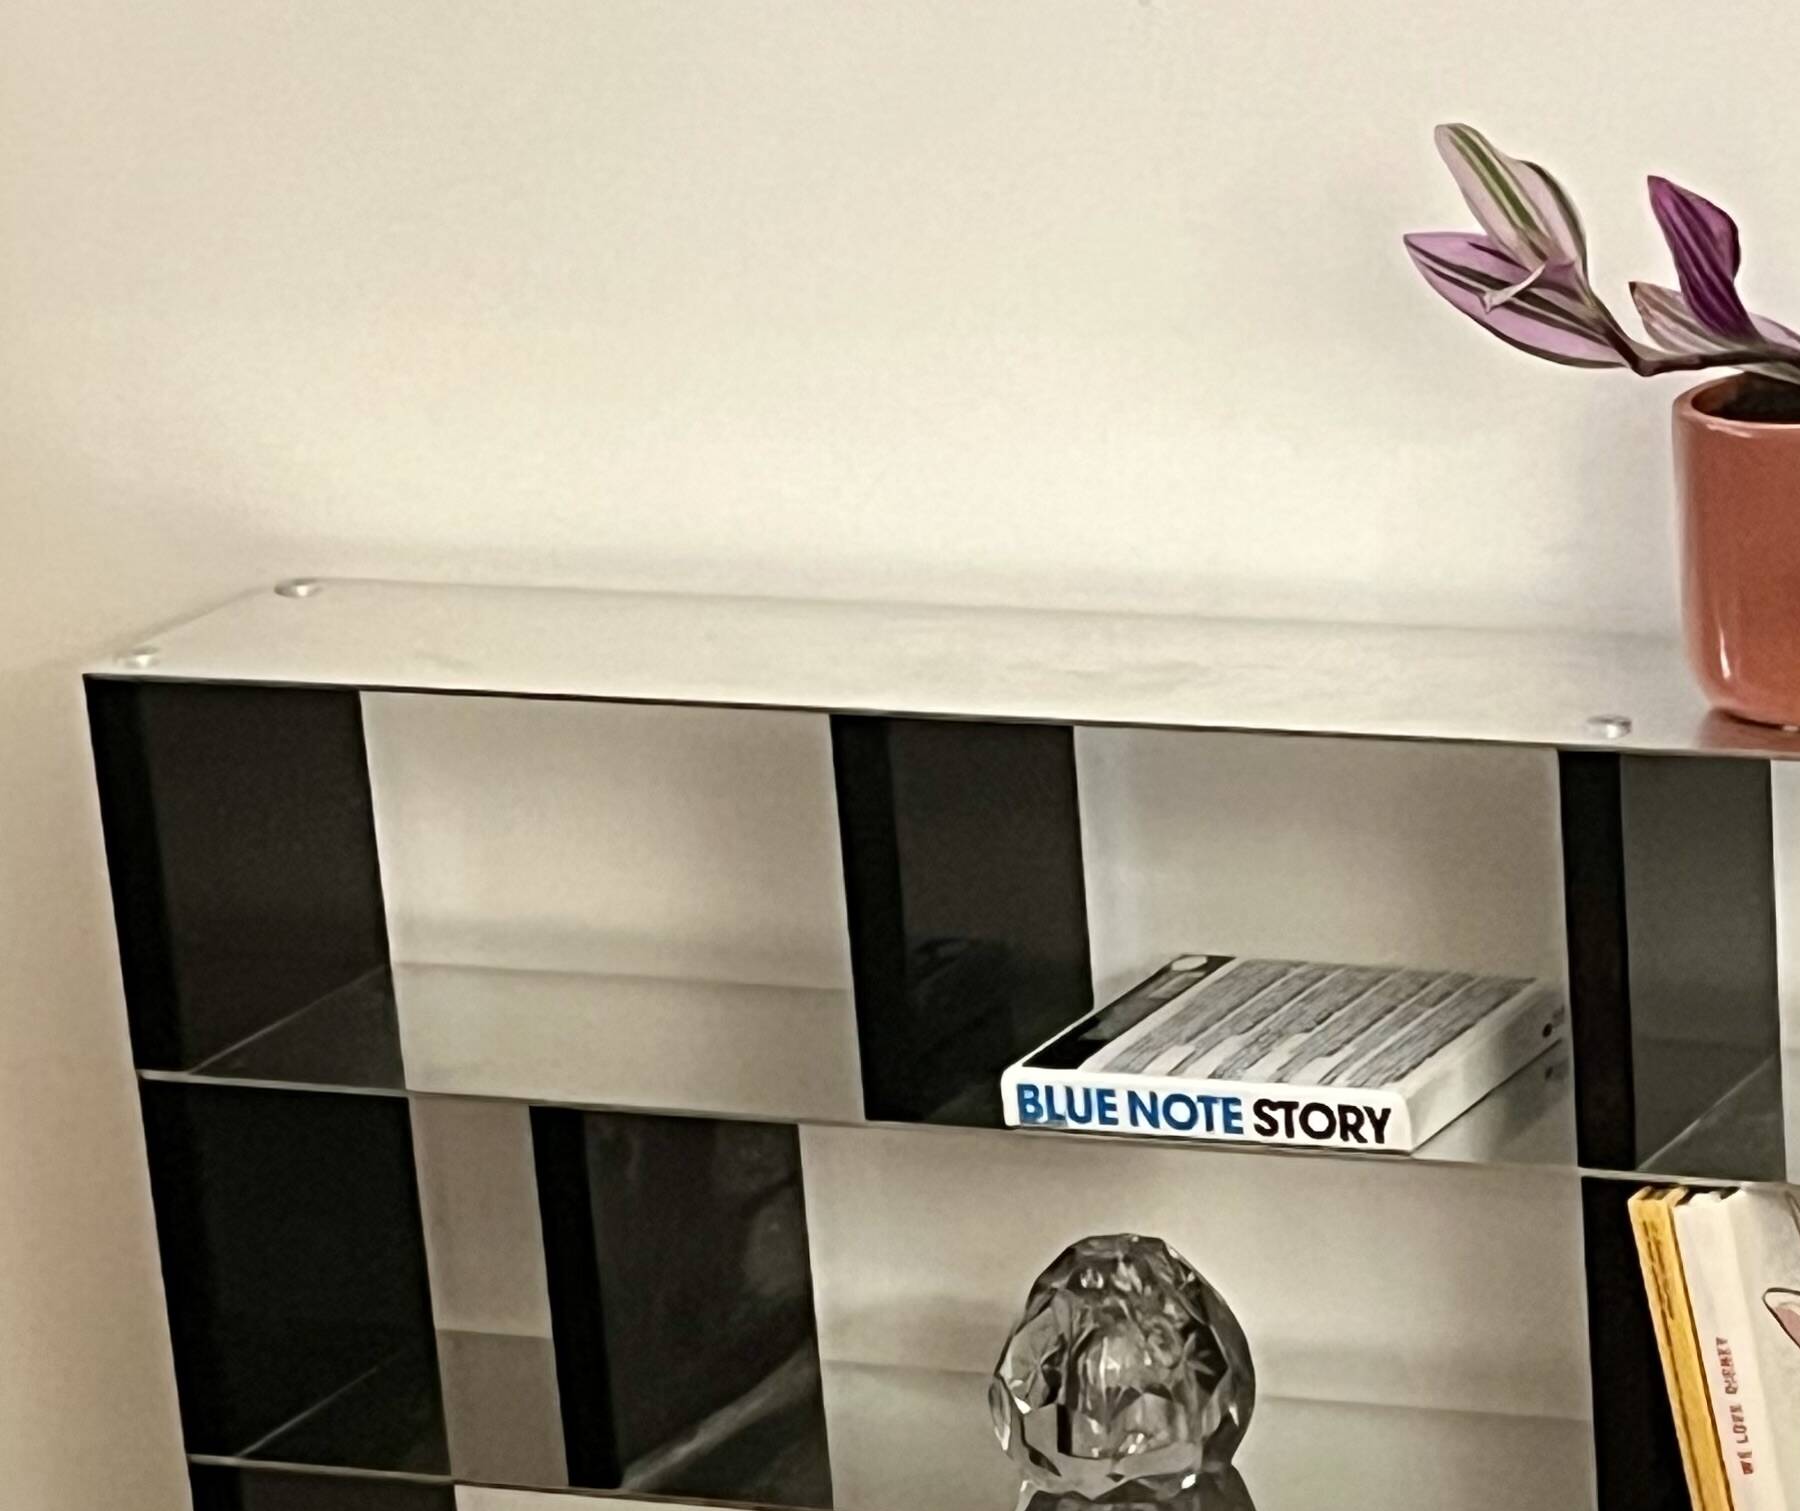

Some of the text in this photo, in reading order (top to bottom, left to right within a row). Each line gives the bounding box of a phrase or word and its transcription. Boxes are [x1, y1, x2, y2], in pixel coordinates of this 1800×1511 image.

[1016, 1083, 1392, 1144] BLUE NOTE STORY
[1729, 1404, 1749, 1444] LOVE
[1737, 1451, 1754, 1475] WE
